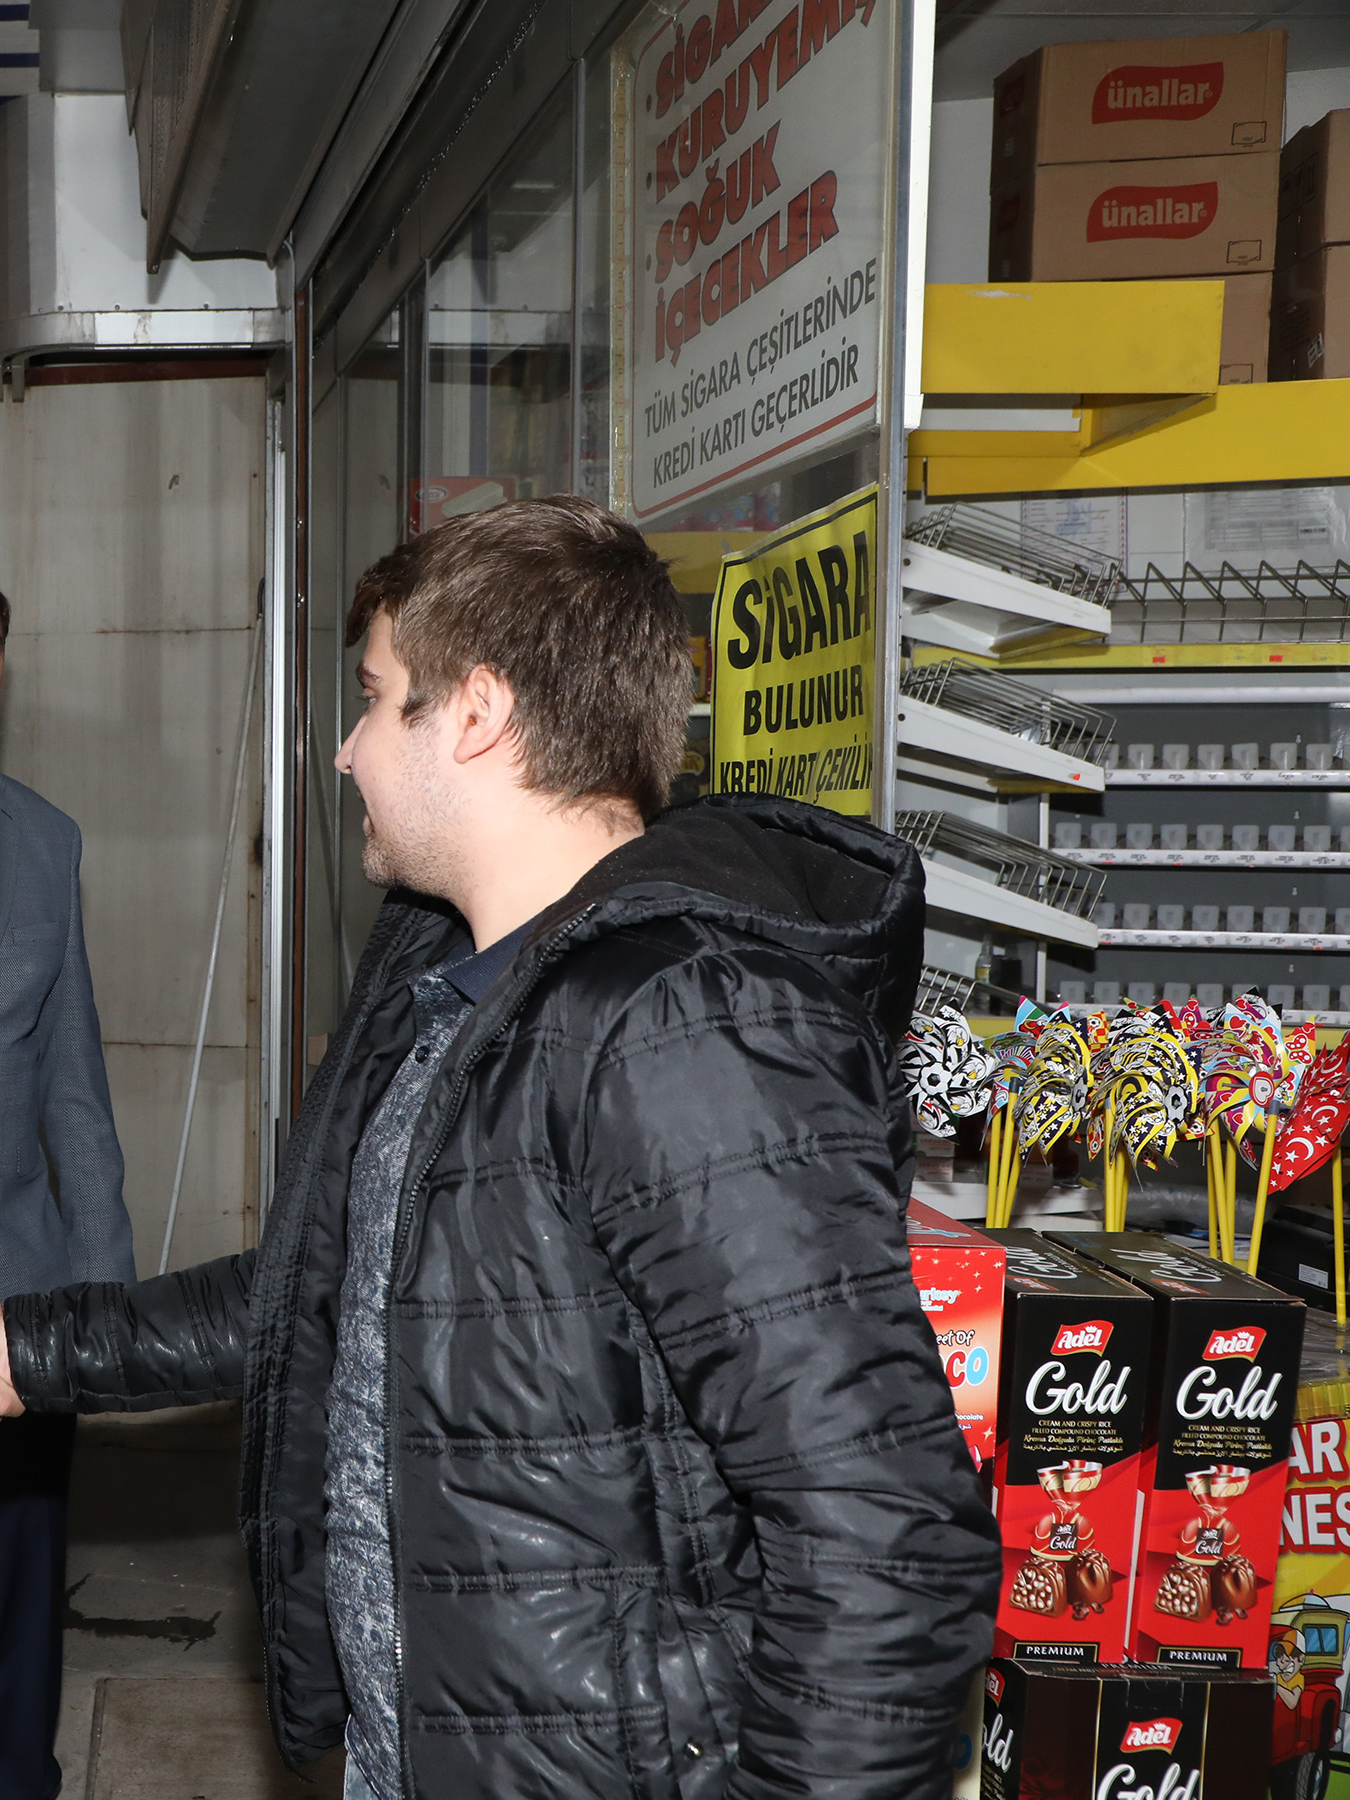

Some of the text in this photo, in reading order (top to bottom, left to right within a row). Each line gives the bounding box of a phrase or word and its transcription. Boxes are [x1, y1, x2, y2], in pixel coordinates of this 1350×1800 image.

[1107, 78, 1210, 110] ünallar
[655, 118, 782, 284] SOĞUK
[1102, 197, 1206, 228] ünallar
[655, 169, 840, 368] İÇECEKLER
[644, 257, 877, 438] TÜM SİGARA ÇEŞİTLERİNDE
[653, 336, 859, 489] KREDİ KARTI GEÇERLİDİR
[727, 529, 872, 671] SİGARA
[742, 663, 865, 736] BULUNUR
[720, 747, 774, 794] KREDİ
[919, 1286, 960, 1304] urkey
[936, 1329, 975, 1346] eet Of
[1057, 1326, 1103, 1350] Adel
[1209, 1333, 1255, 1355] Adel
[940, 1346, 989, 1390] CO
[1025, 1360, 1132, 1415] Gold
[1176, 1365, 1283, 1421] Gold
[1050, 1535, 1077, 1550] Gold
[1195, 1540, 1223, 1554] Gold
[1026, 1645, 1084, 1656] PREMIUM
[1169, 1650, 1227, 1662] PREMIUM
[1126, 1723, 1172, 1747] Adel
